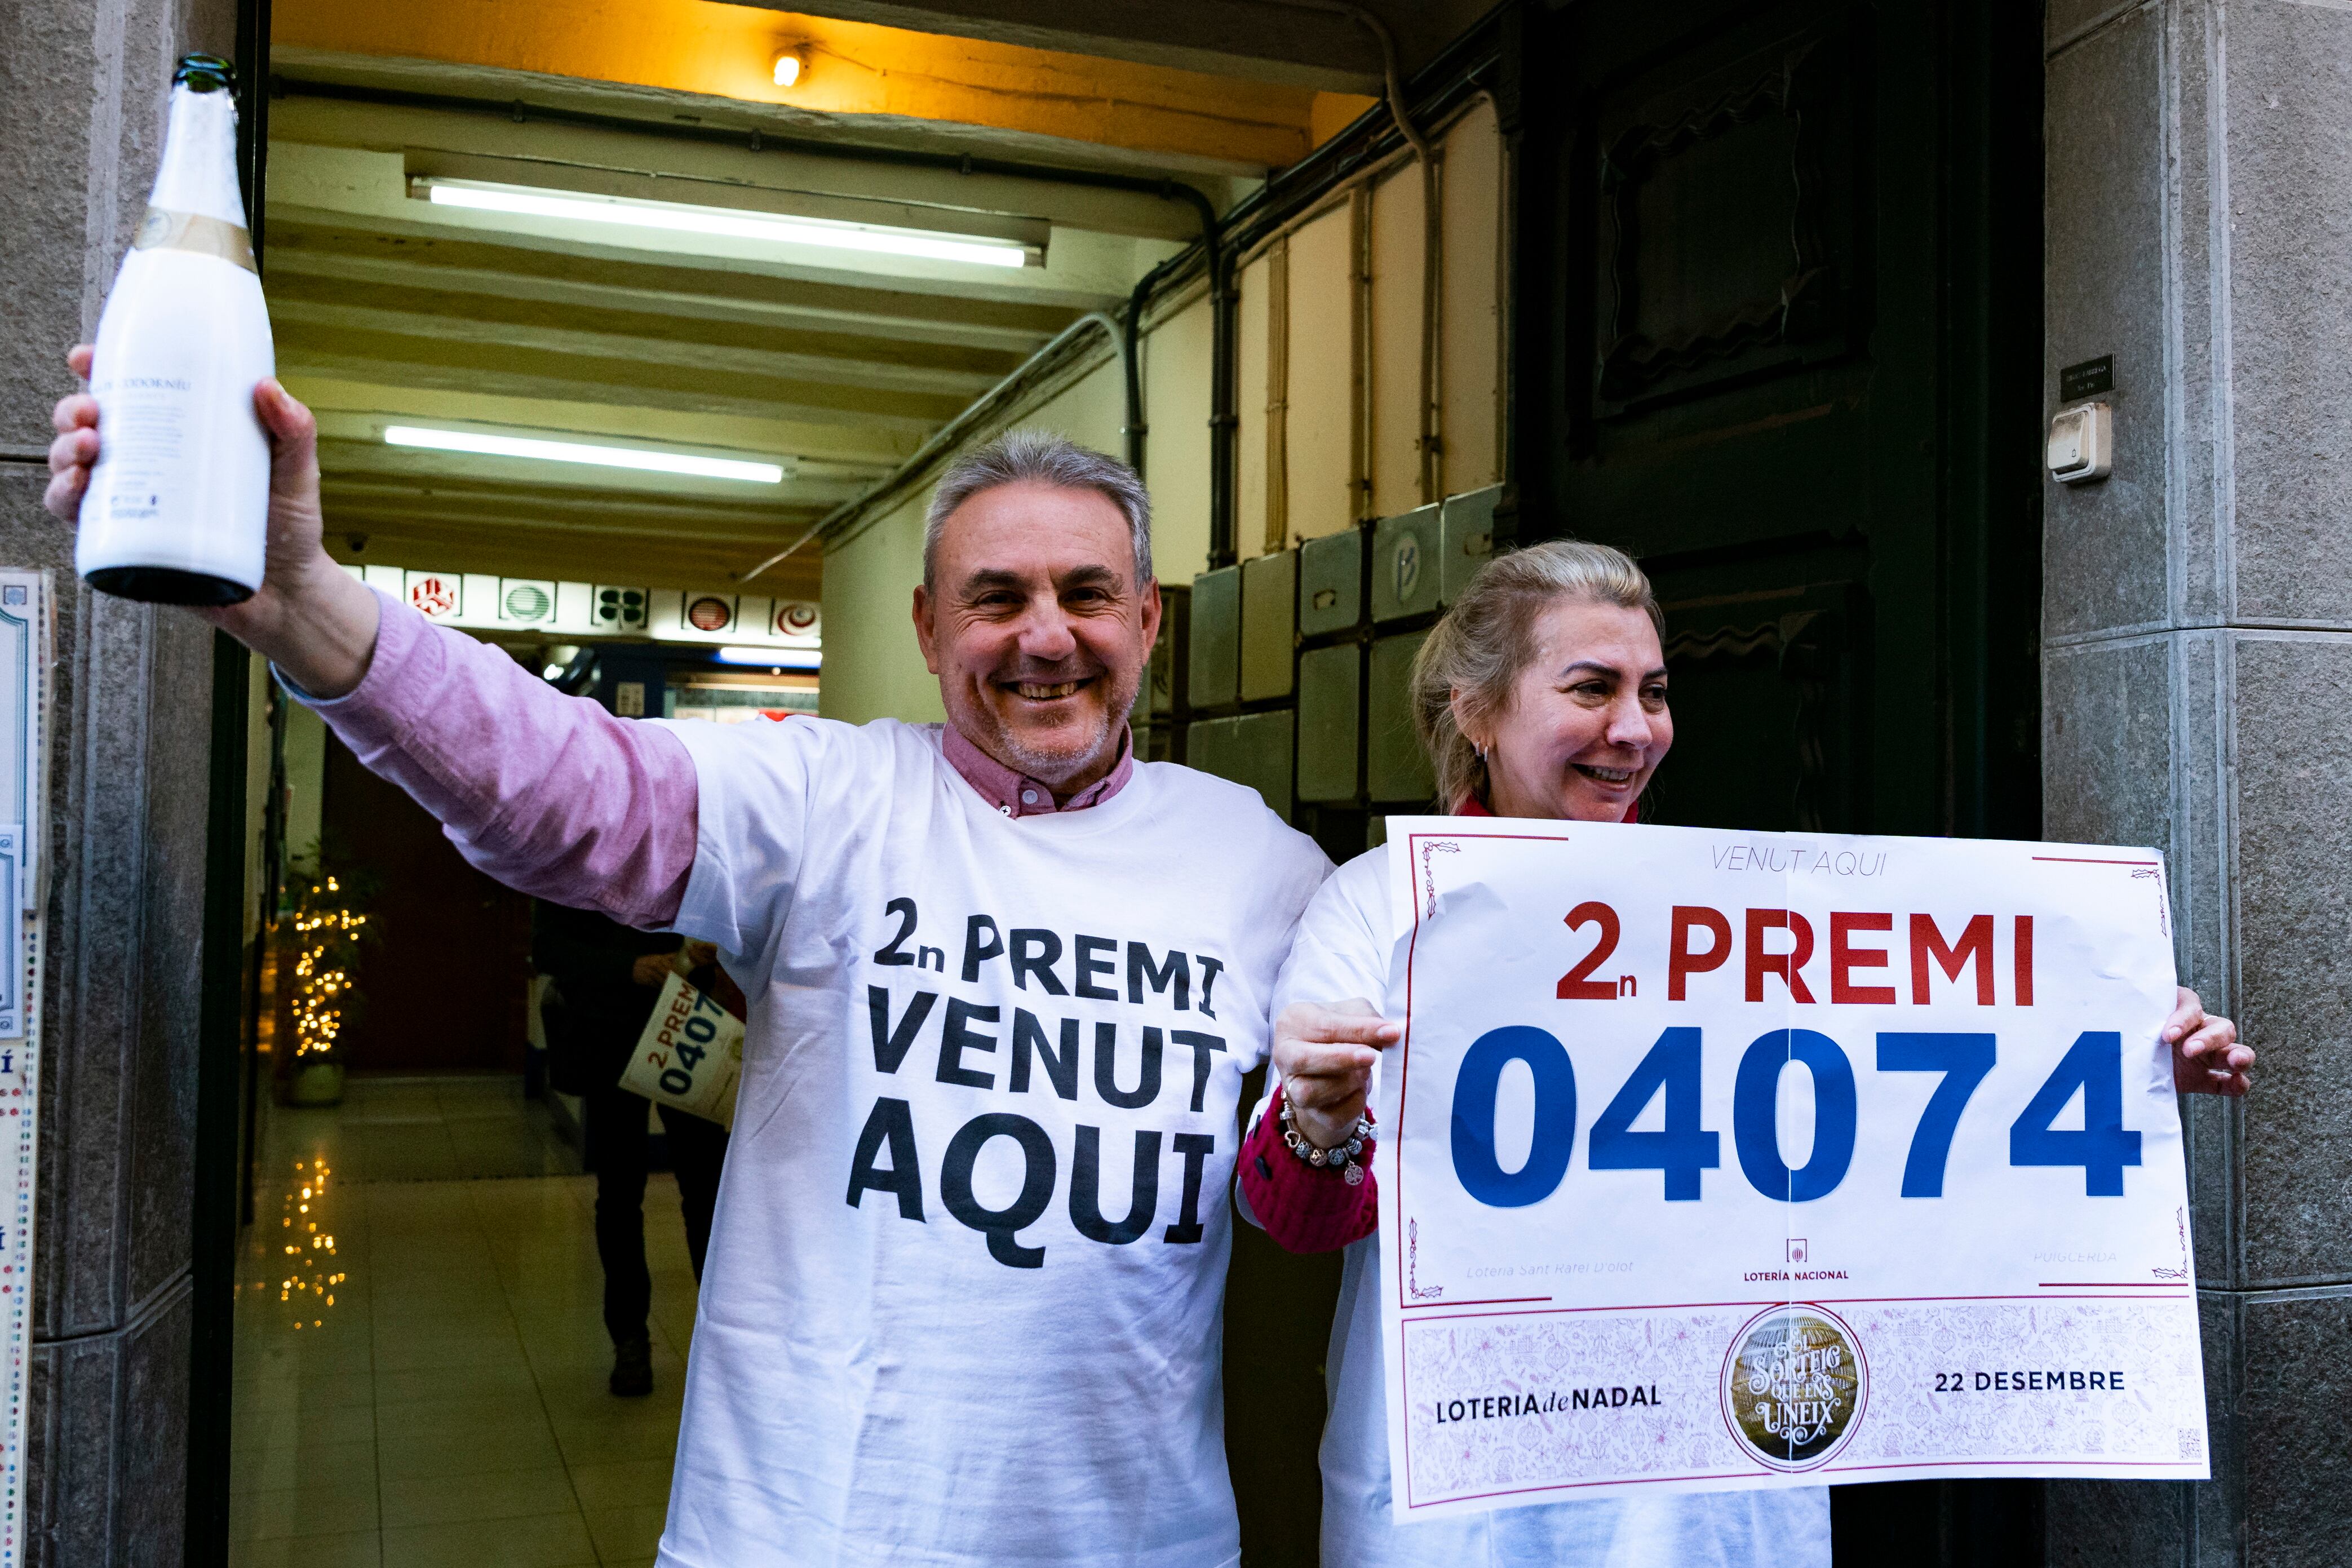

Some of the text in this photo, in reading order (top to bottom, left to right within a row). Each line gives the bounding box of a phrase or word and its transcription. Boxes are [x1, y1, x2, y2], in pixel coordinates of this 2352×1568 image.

[1712, 845, 1886, 876] VENUT AQUI
[874, 897, 1224, 1021] 2n PREMI
[1556, 901, 2034, 1007] 2n PREMI
[867, 984, 1228, 1113] VENUT
[1450, 1024, 2143, 1208] 04074
[845, 1096, 1215, 1269] AQUI
[1744, 1270, 1849, 1282] LOTERÍA NACIONAL
[1934, 1371, 2125, 1392] 22 DESEMBRE
